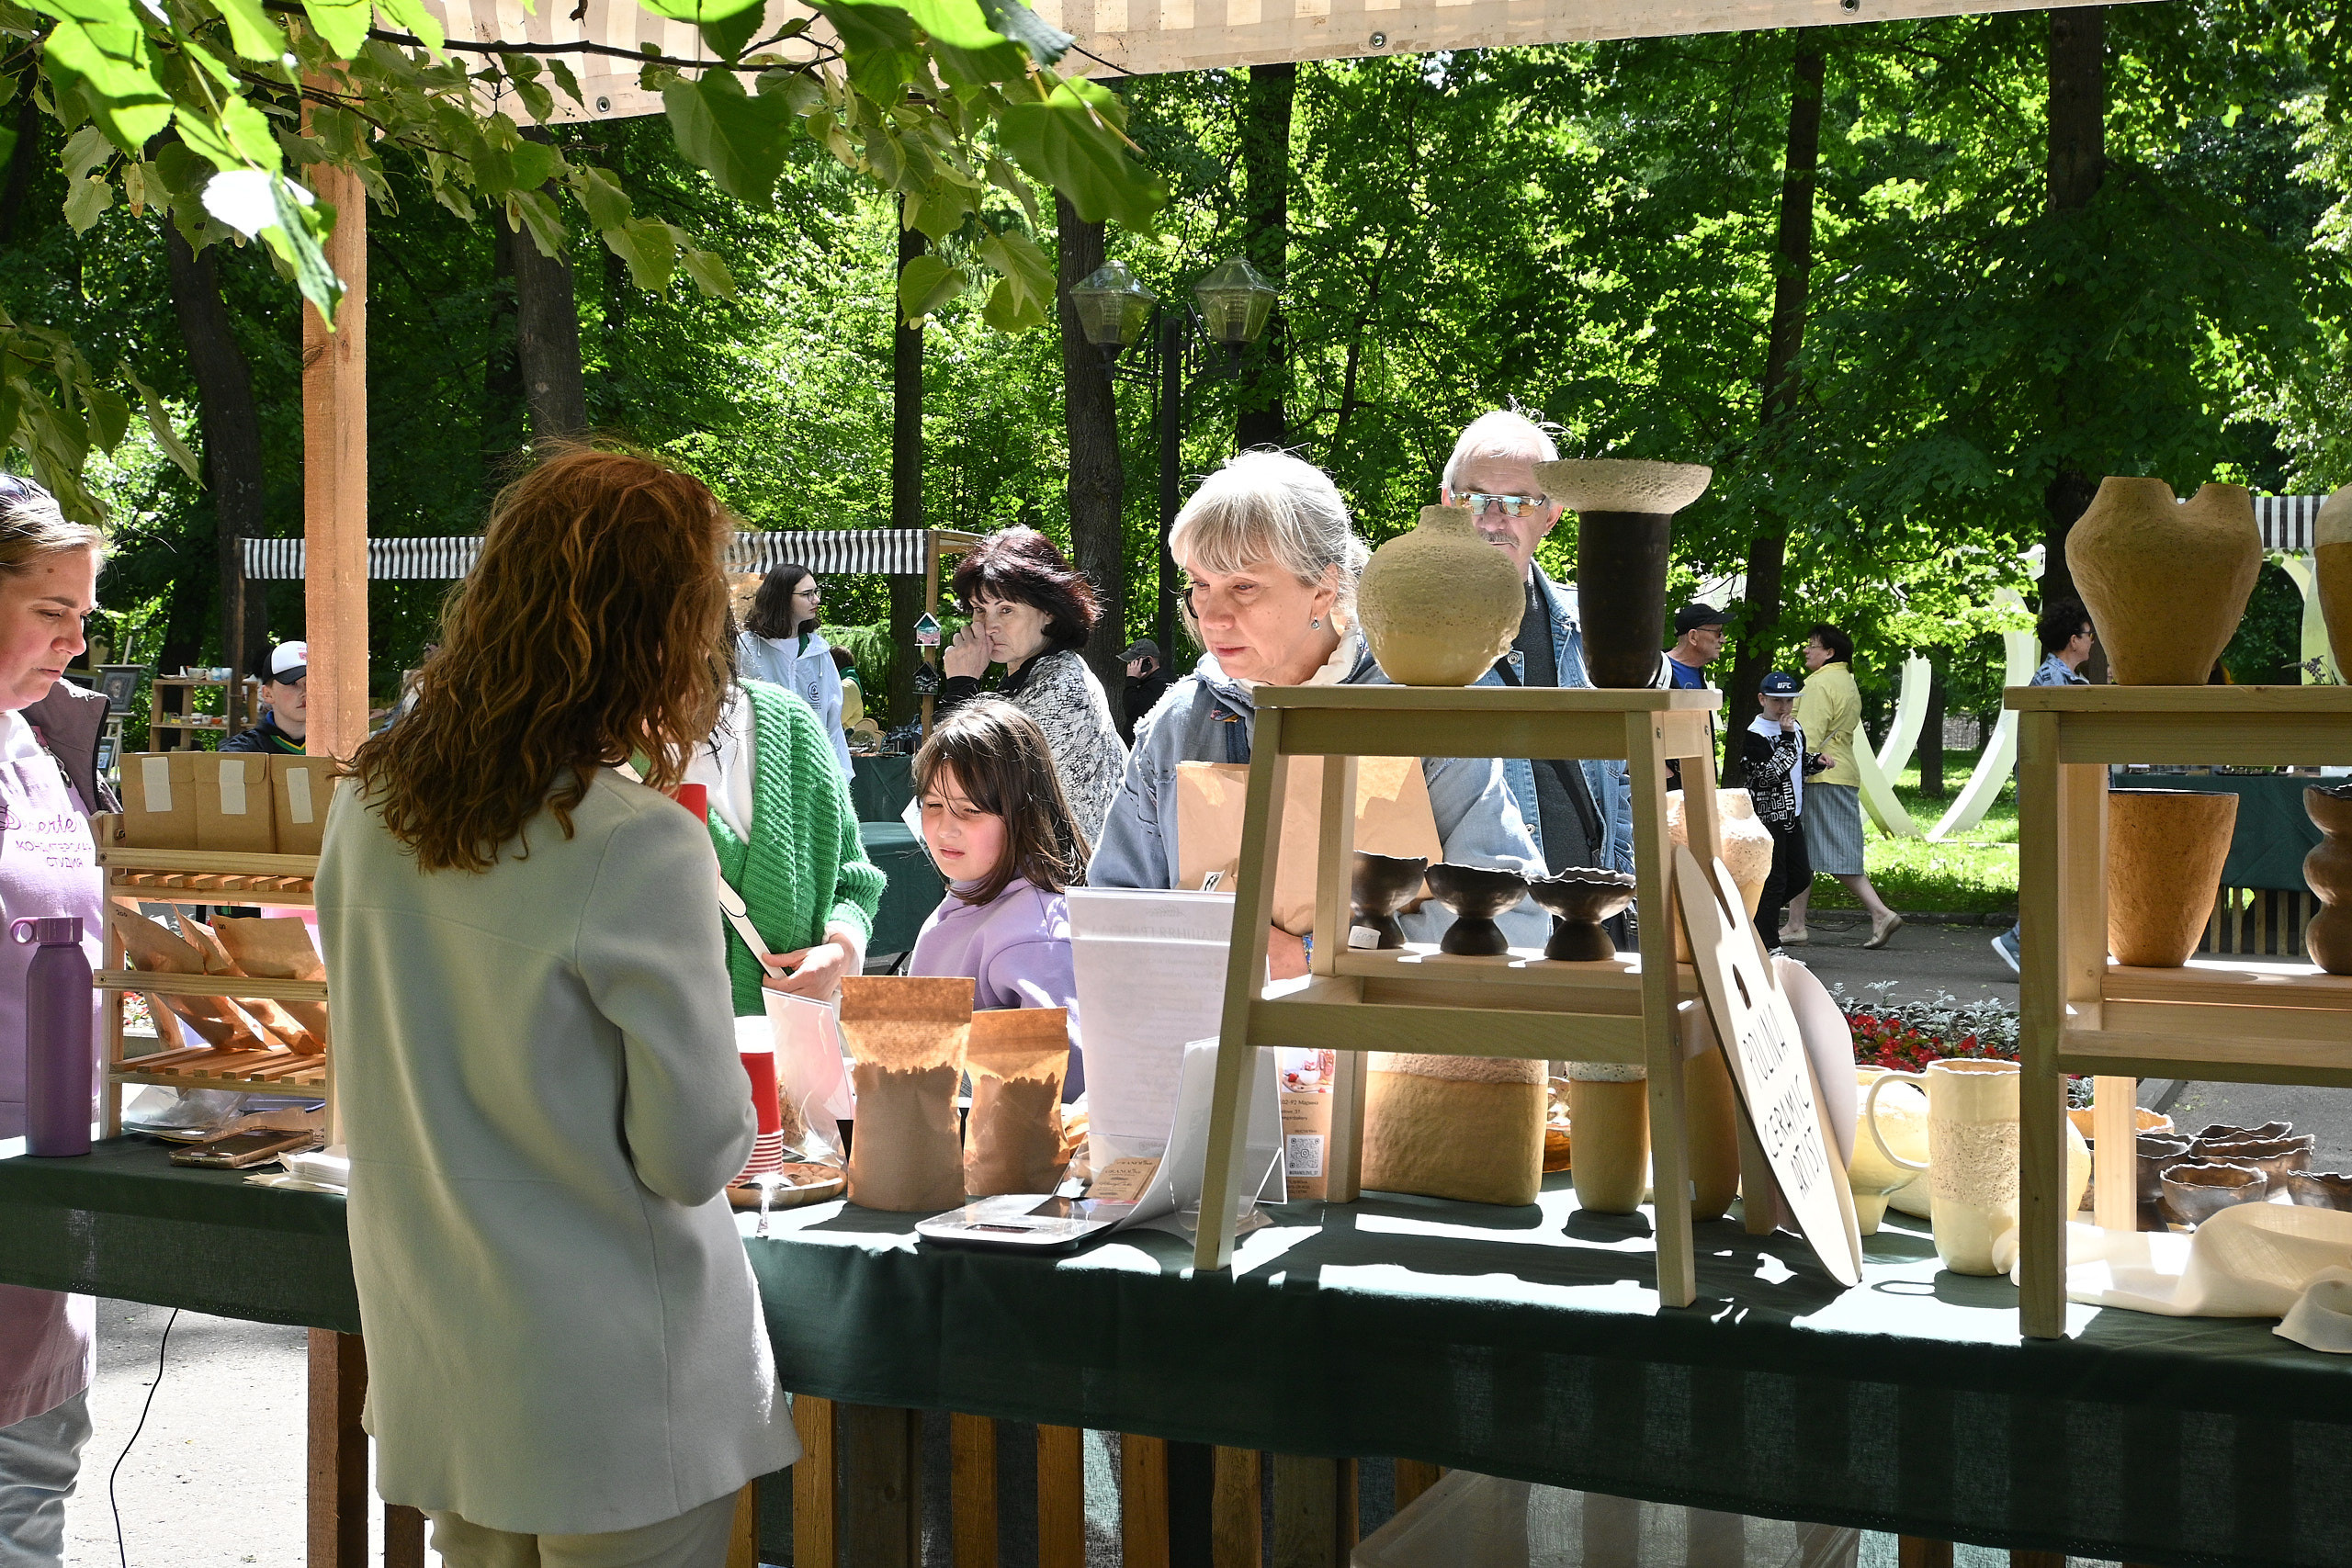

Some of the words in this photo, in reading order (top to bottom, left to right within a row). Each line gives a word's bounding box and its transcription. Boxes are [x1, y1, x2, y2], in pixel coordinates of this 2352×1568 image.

[46, 856, 84, 868] СТУДИЯ
[1743, 1003, 1789, 1089] POLINA
[1764, 1074, 1809, 1158] CERAMIC
[1791, 1126, 1825, 1200] ARTIST
